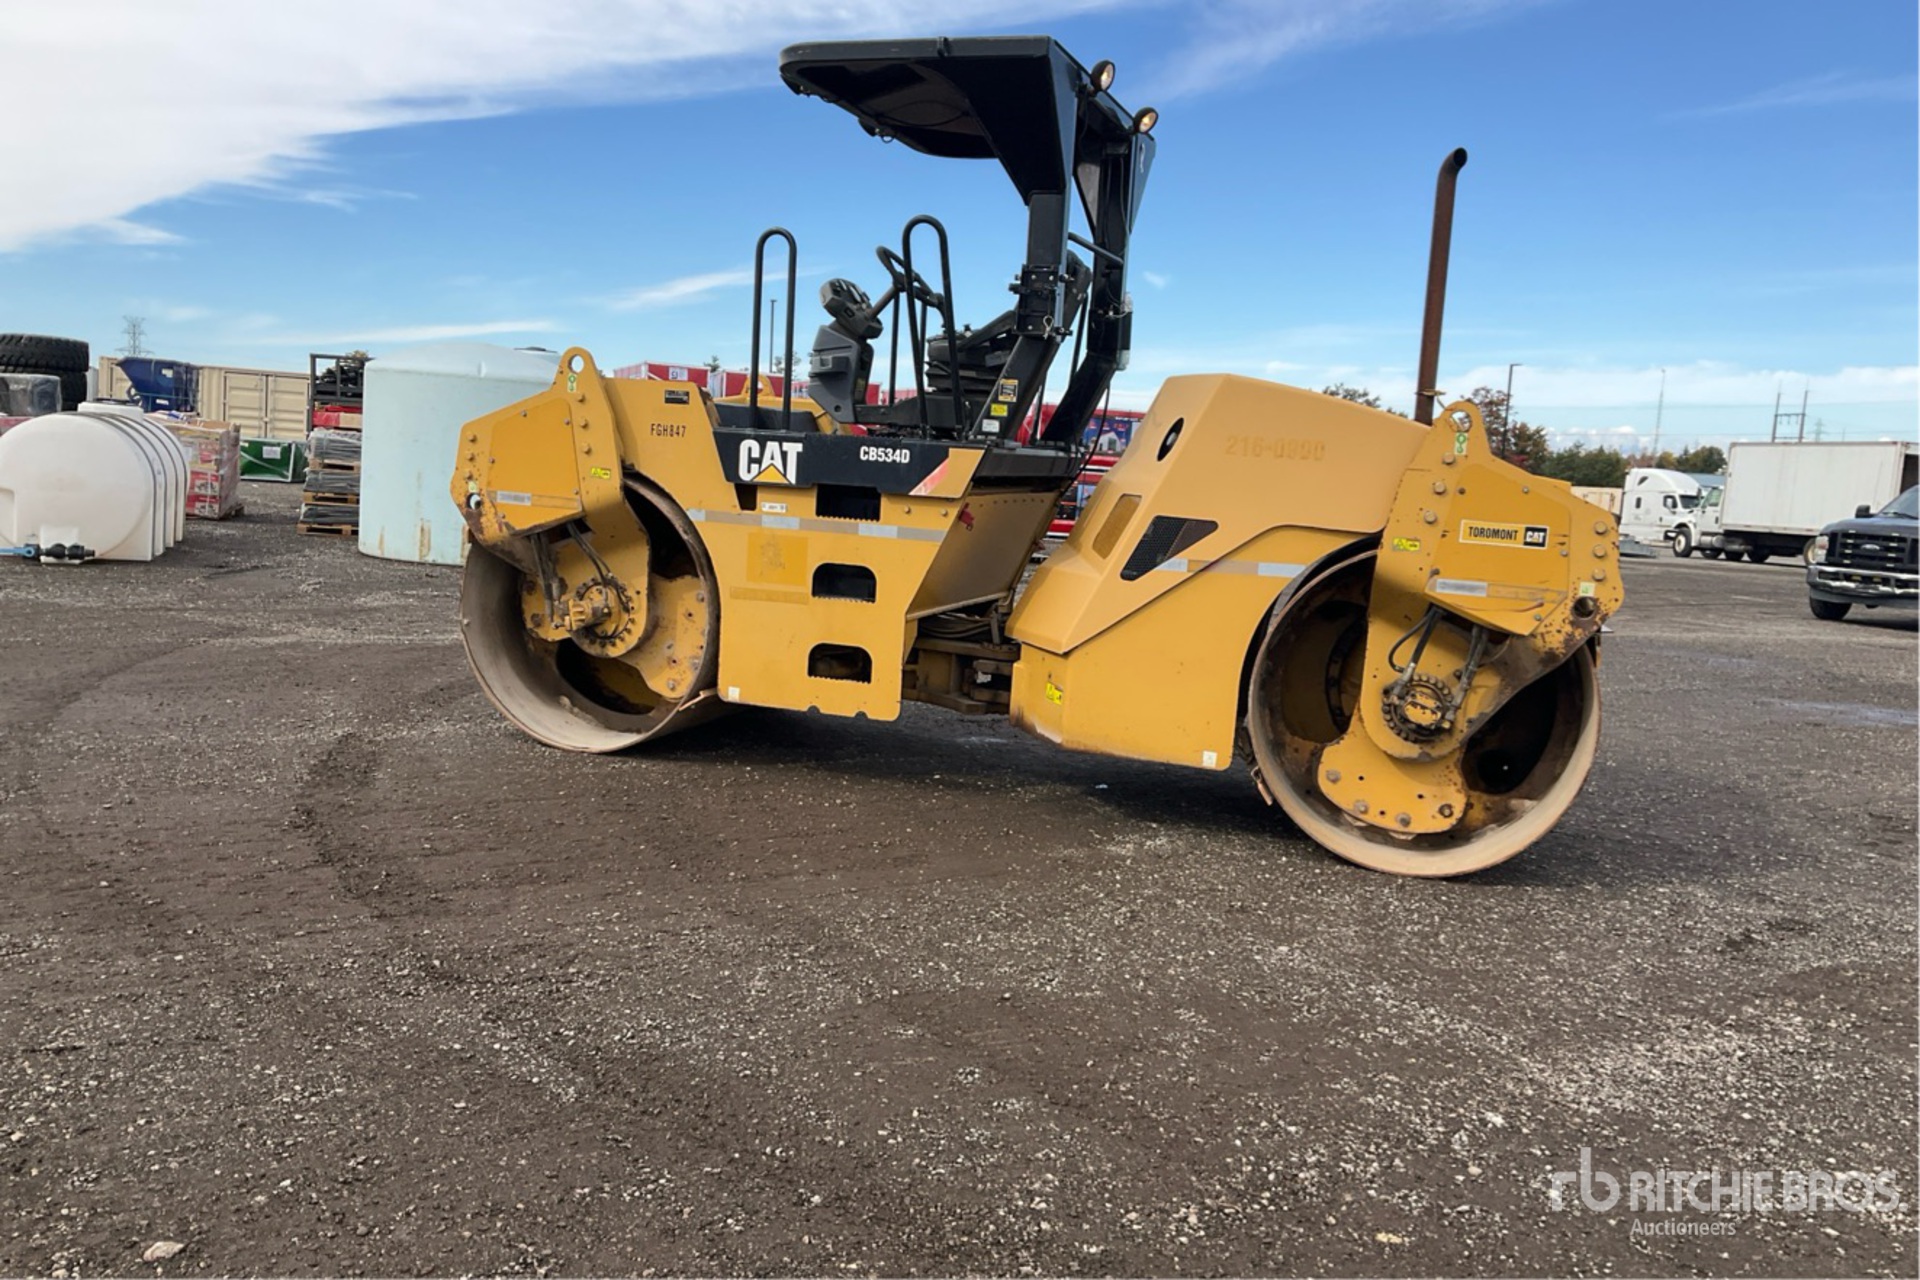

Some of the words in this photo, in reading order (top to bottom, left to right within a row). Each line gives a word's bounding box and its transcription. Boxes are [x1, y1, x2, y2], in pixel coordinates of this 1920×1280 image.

[650, 423, 687, 438] FGH847
[738, 439, 803, 484] CAT
[859, 446, 911, 464] CB534D
[1468, 525, 1519, 541] TOROMONT
[1525, 531, 1545, 544] CAT
